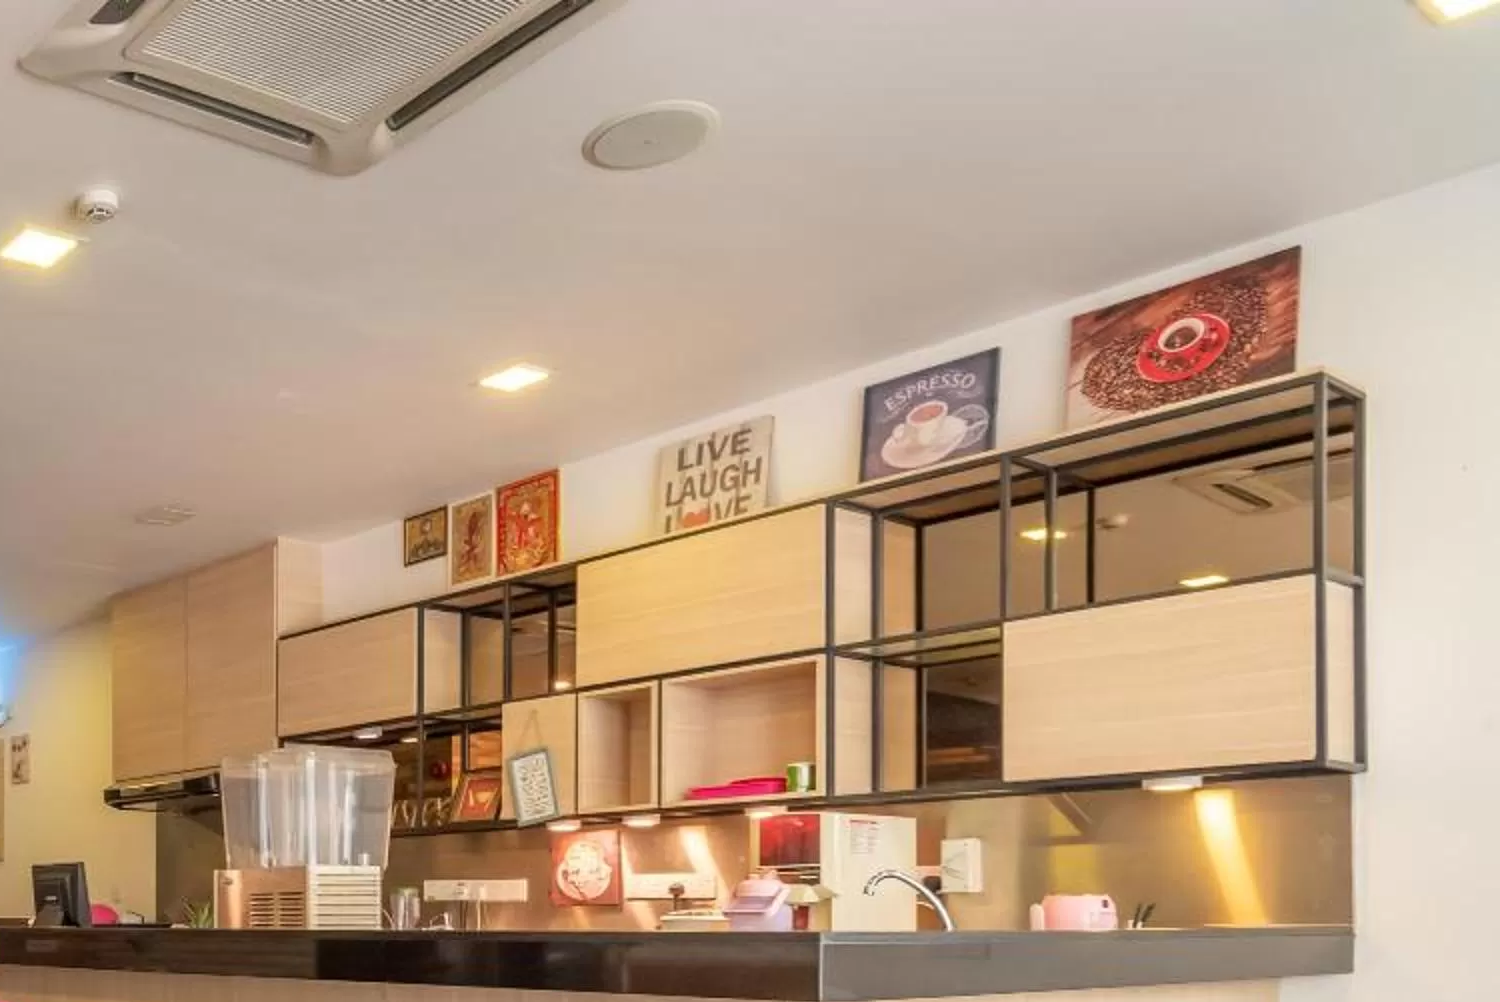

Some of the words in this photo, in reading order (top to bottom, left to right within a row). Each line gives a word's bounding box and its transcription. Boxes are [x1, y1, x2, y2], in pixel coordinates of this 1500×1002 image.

[884, 373, 976, 411] ESPRESSO
[678, 428, 752, 472] LIVE
[666, 456, 762, 507] LAUGH
